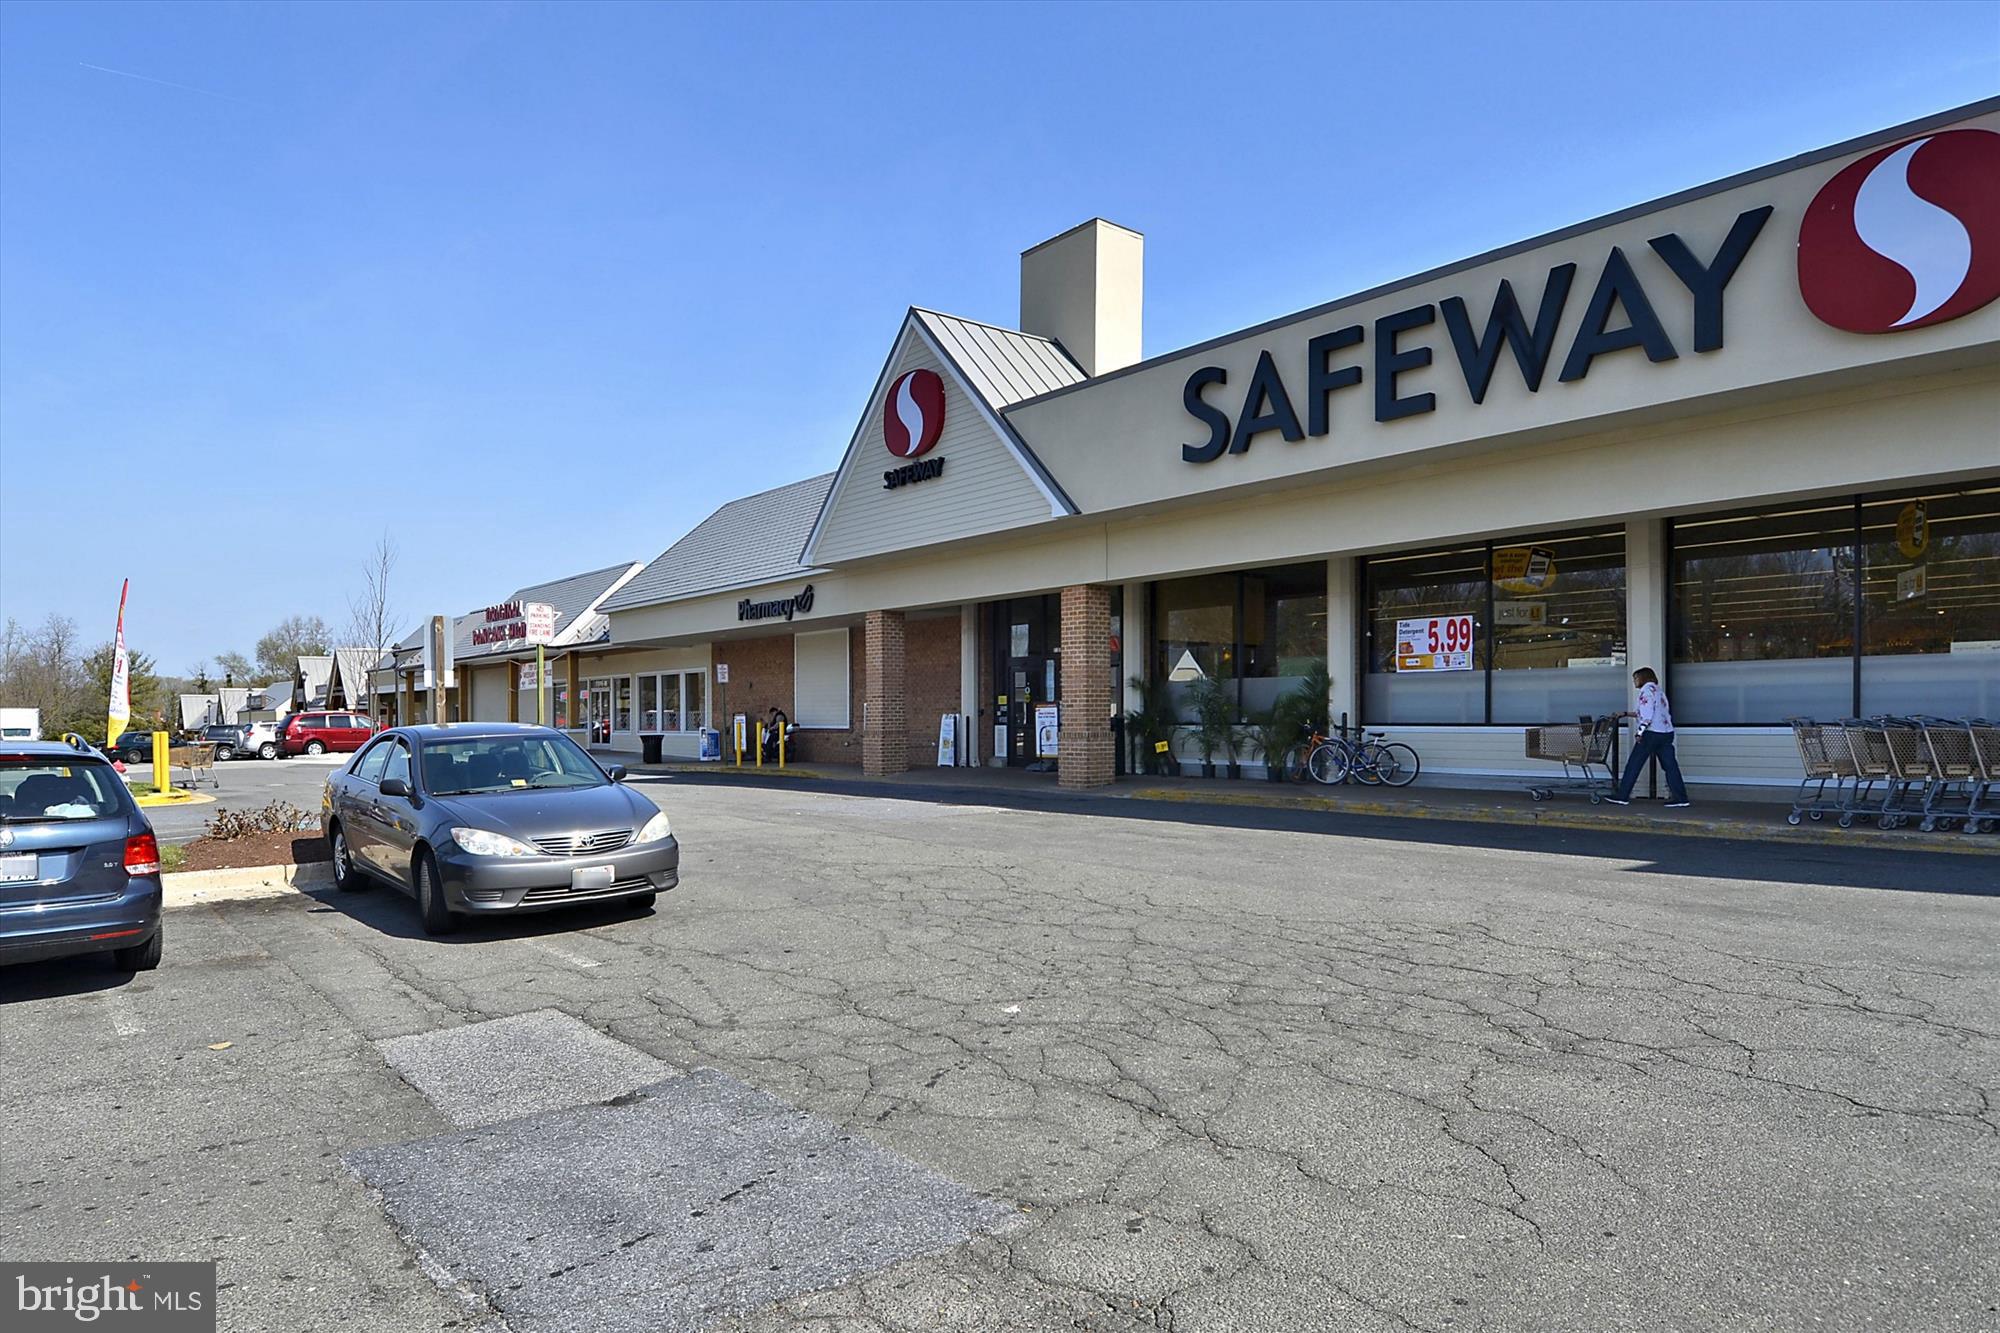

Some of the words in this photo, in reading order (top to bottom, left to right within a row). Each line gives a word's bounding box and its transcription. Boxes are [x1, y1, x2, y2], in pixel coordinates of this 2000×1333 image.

[1181, 204, 1775, 464] SAFEWAY
[883, 456, 946, 490] SAFEWAY
[486, 600, 522, 622] ORIGINAL
[737, 598, 795, 621] Pharmacy
[472, 625, 506, 645] PANCAKE
[1399, 628, 1425, 636] Detergent
[1428, 618, 1471, 653] 5.99
